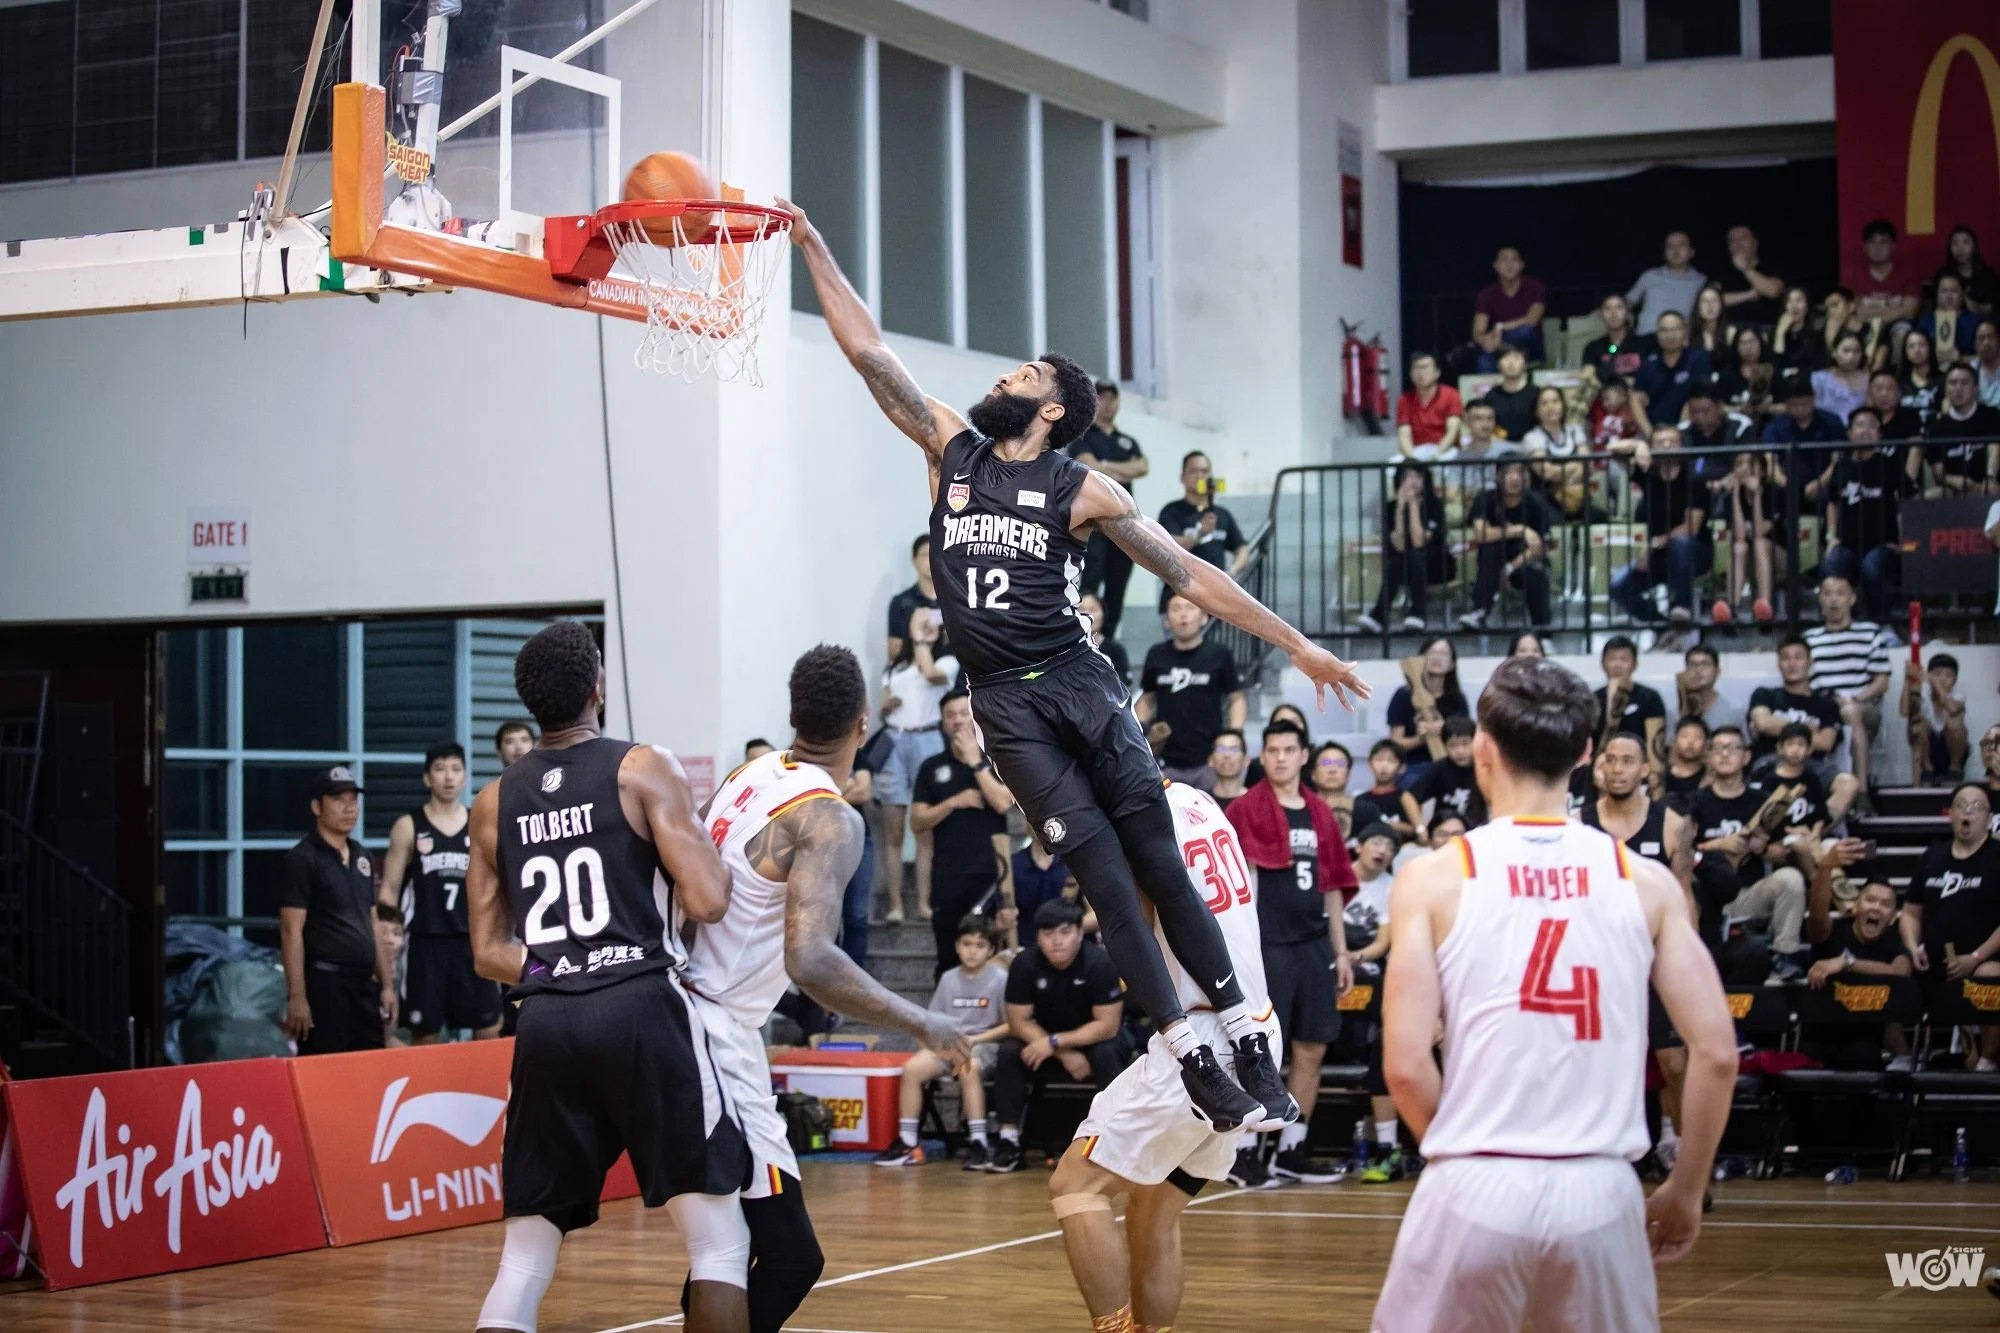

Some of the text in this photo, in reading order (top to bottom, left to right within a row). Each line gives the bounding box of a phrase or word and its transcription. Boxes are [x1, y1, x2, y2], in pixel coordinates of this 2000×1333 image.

[389, 144, 431, 168] SAIGON
[399, 162, 429, 183] HEAT
[588, 280, 636, 306] CANADIAN
[952, 486, 968, 496] ABL
[193, 522, 235, 547] GATE
[942, 513, 1050, 561] DREAMERS
[1930, 527, 1993, 557] PRE
[966, 542, 1018, 561] FORMOSA
[966, 567, 1011, 610] 12
[516, 802, 594, 845] TOLBERT
[1183, 828, 1253, 915] 30
[1296, 861, 1313, 891] 5
[443, 883, 459, 911] 7
[520, 846, 611, 945] 20
[1519, 917, 1603, 1041] 4
[825, 1098, 864, 1116] GON
[830, 1114, 862, 1130] EAT
[382, 1163, 502, 1222] LI-NIN
